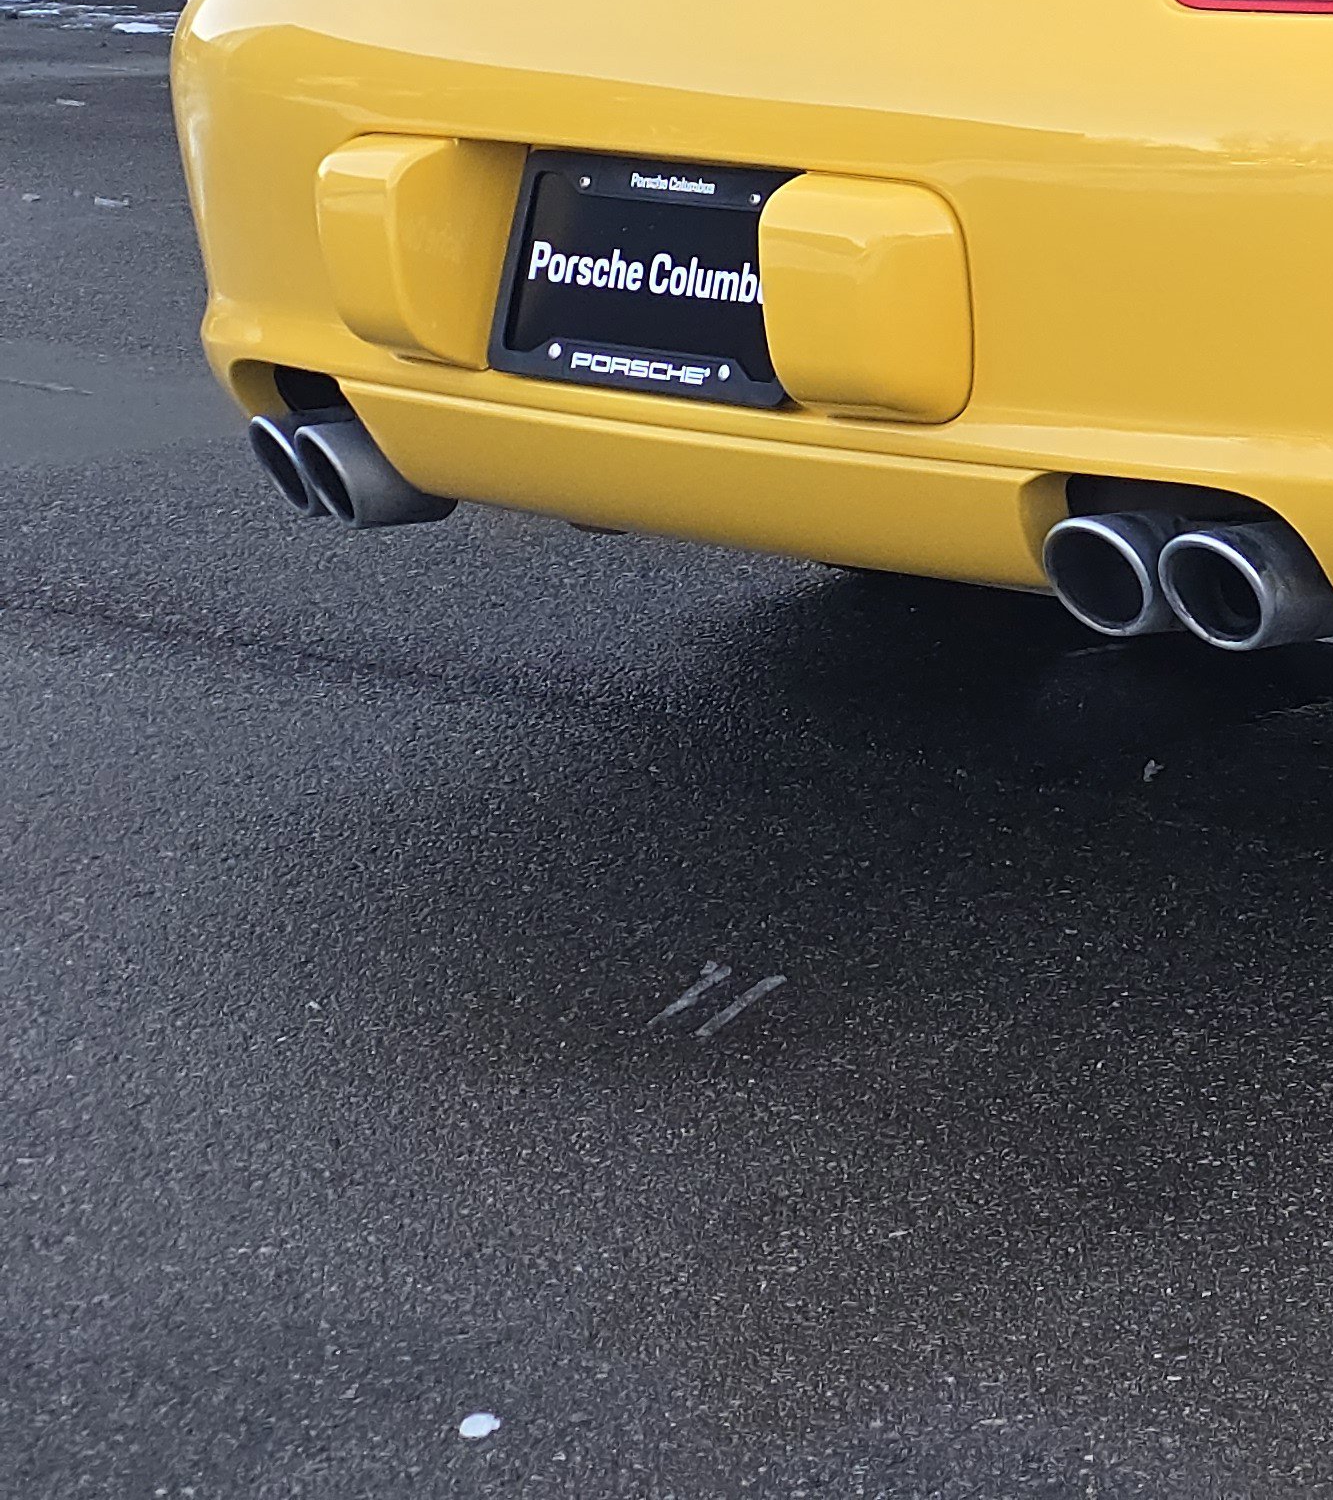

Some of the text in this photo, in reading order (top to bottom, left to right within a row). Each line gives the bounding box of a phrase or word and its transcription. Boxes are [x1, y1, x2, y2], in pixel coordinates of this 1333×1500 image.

[630, 172, 668, 190] Porsche
[528, 241, 763, 305] Porsche Columb
[571, 352, 711, 385] PORSCHE
